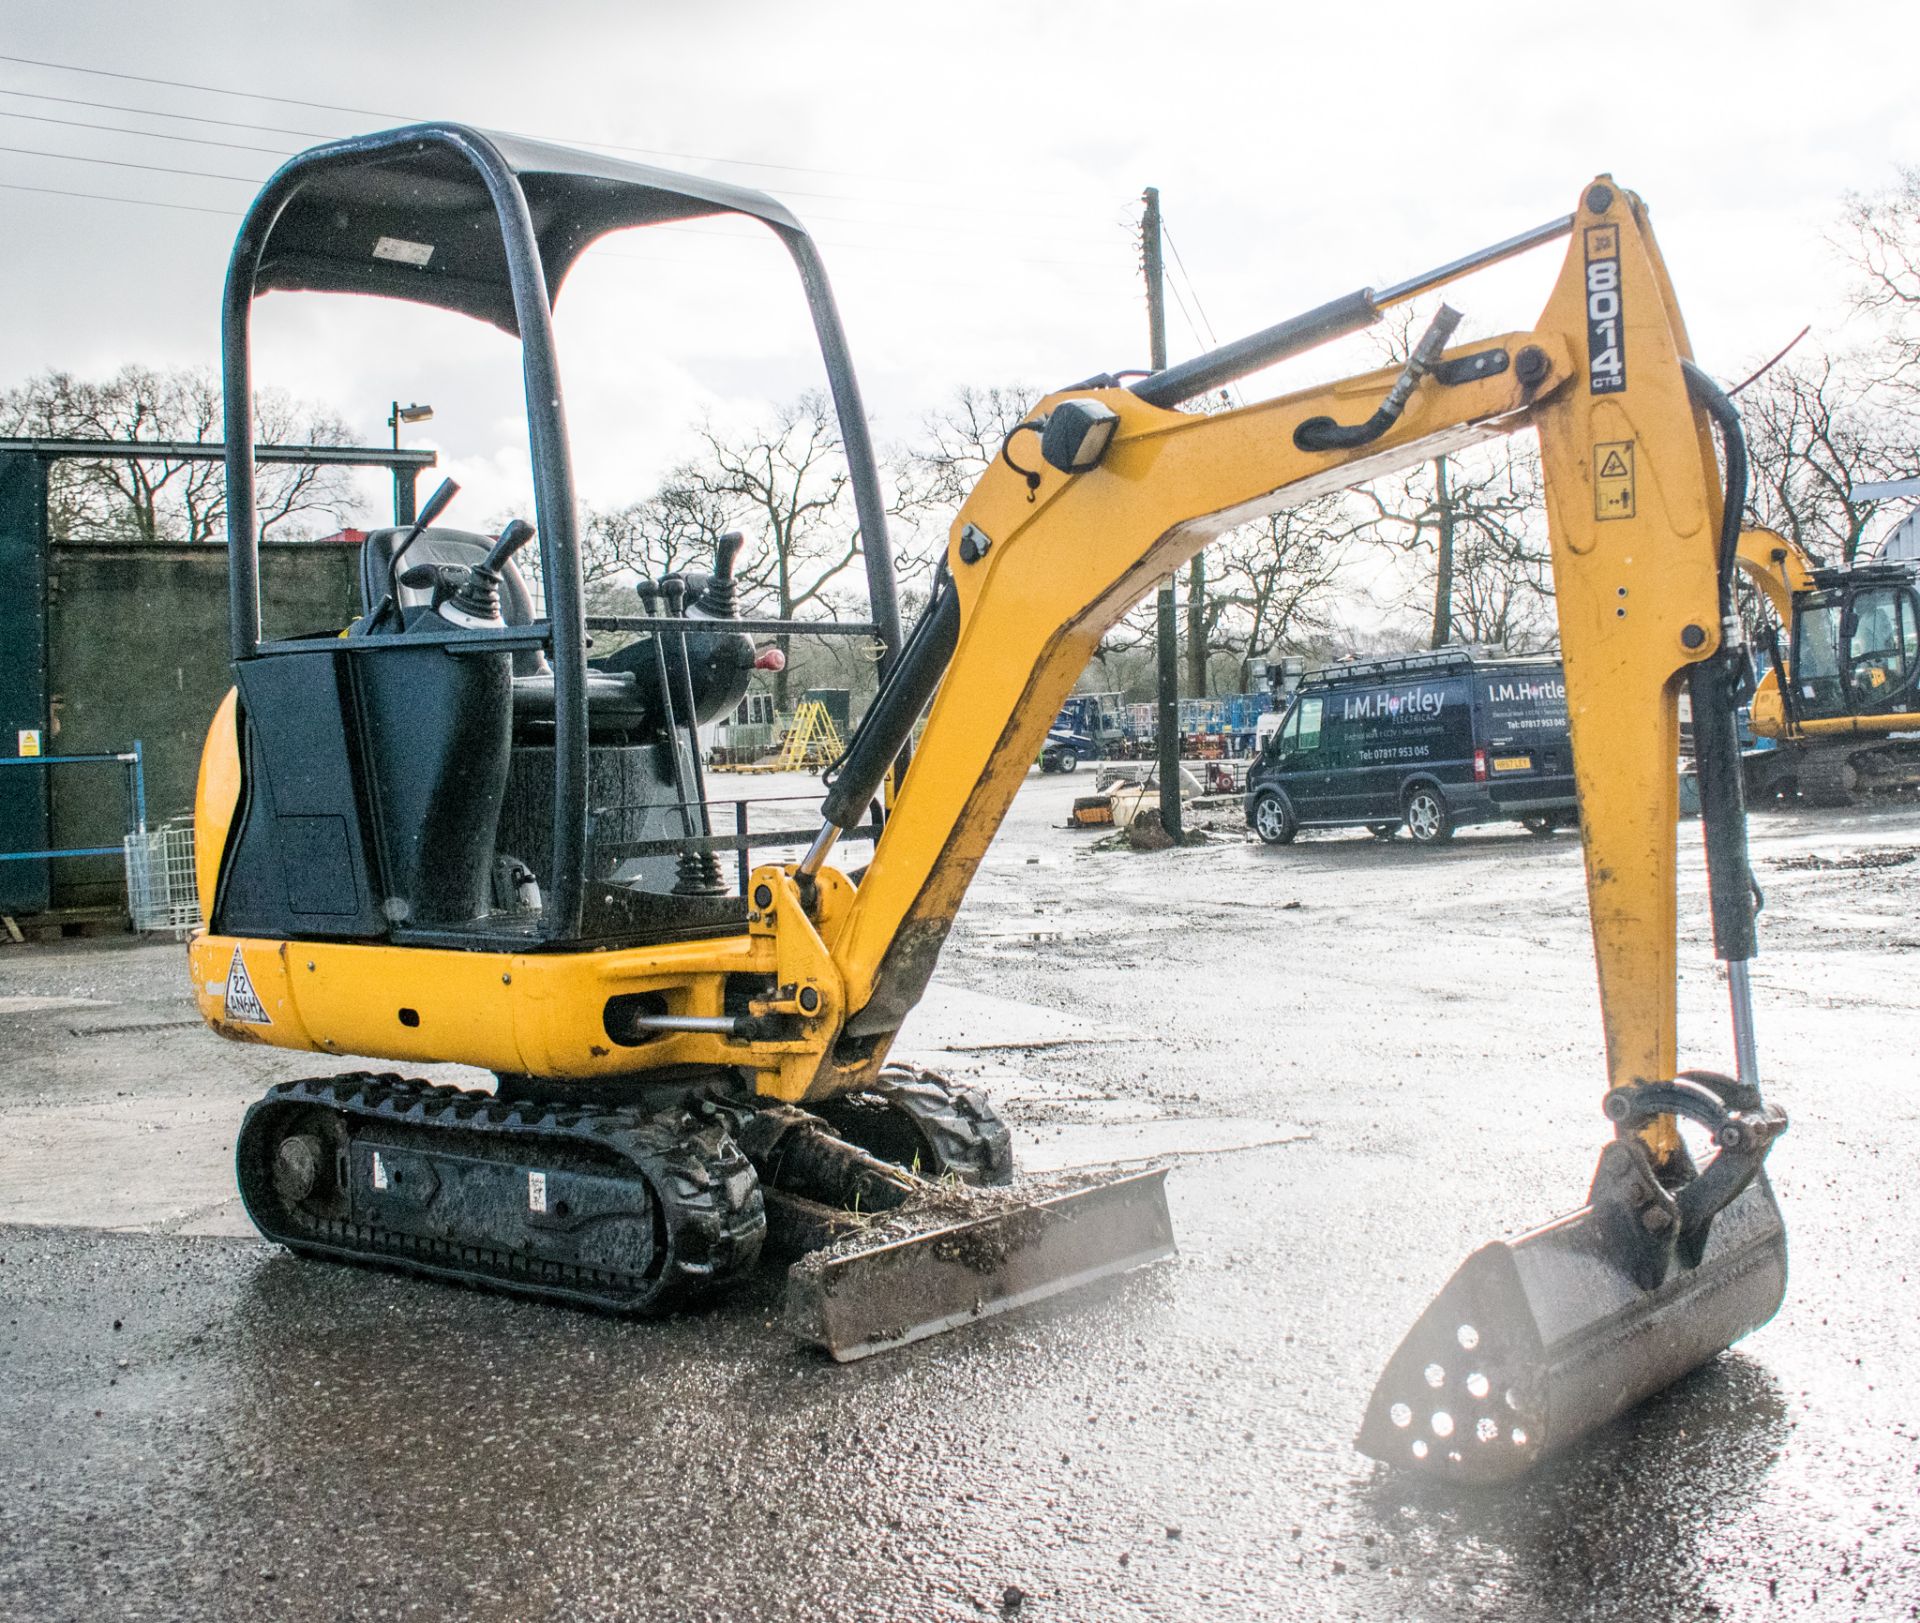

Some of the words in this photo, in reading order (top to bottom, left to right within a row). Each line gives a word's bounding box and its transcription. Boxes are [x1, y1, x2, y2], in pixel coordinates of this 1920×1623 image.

[1588, 261, 1622, 375] 8014
[1592, 376, 1622, 388] CTS
[1360, 750, 1373, 760] Tel:
[1374, 748, 1396, 759] 07817
[1399, 746, 1413, 757] 953
[1414, 745, 1429, 756] 045
[233, 975, 247, 994] 22
